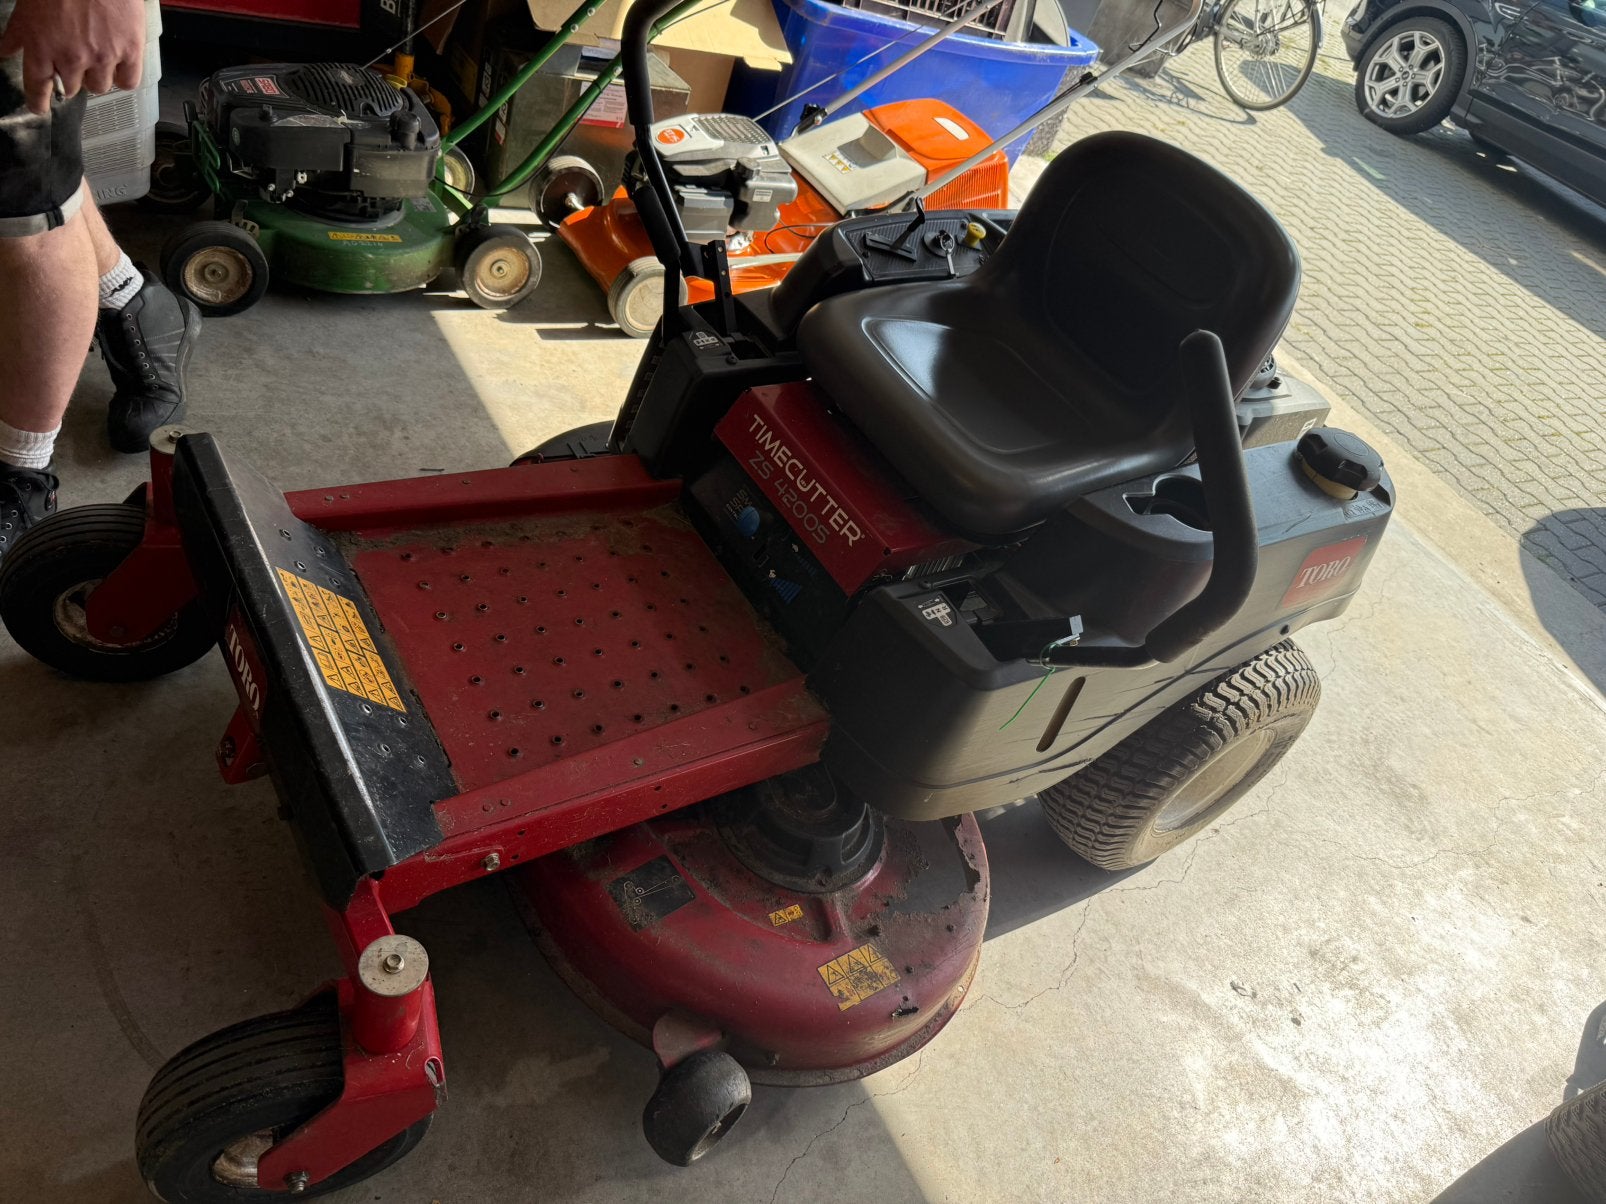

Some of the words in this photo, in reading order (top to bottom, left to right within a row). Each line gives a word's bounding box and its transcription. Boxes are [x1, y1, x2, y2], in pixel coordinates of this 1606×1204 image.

[748, 414, 863, 547] TIMECUTTER
[749, 450, 774, 479] ZS
[774, 478, 830, 544] 4200S
[1296, 556, 1351, 589] TORO
[229, 623, 260, 711] TORO
